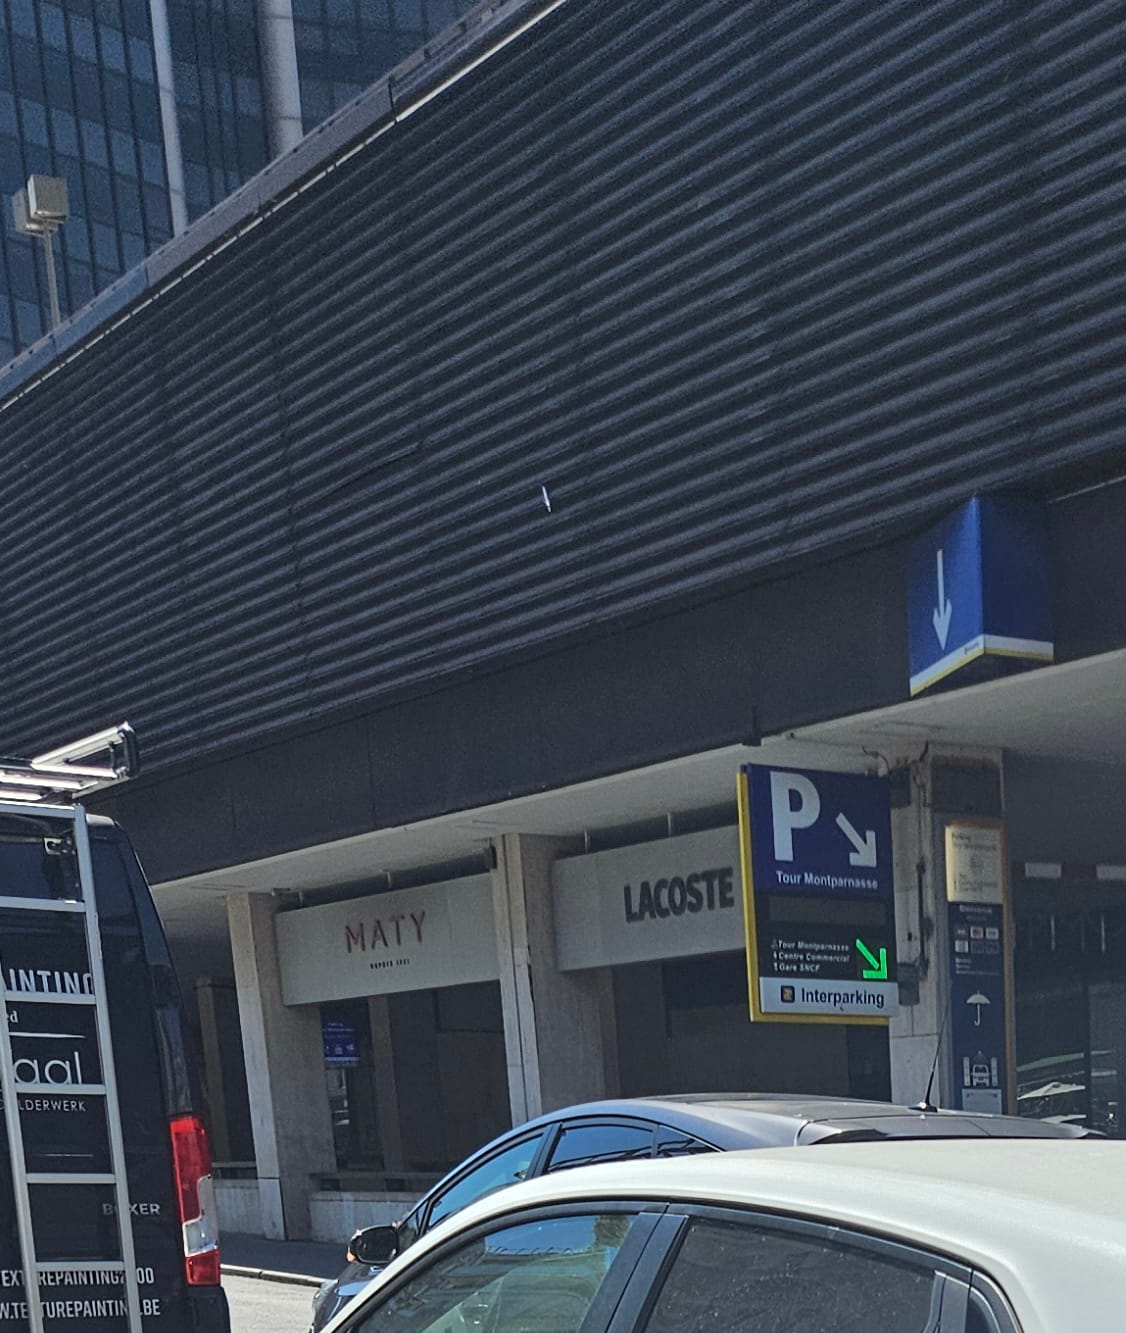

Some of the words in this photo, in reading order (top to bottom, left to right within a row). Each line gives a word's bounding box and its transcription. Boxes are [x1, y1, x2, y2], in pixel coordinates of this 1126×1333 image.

[770, 771, 821, 862] P
[776, 870, 801, 885] Tour
[804, 872, 878, 890] Montparnasse
[624, 867, 734, 923] LACOSTE
[345, 911, 426, 953] MATY
[779, 940, 795, 949] Tour
[798, 941, 849, 952] Montparnasse
[779, 952, 803, 960] Centre
[806, 953, 850, 962] Commercial
[801, 987, 884, 1008] Interparking
[103, 1203, 160, 1216] BXER
